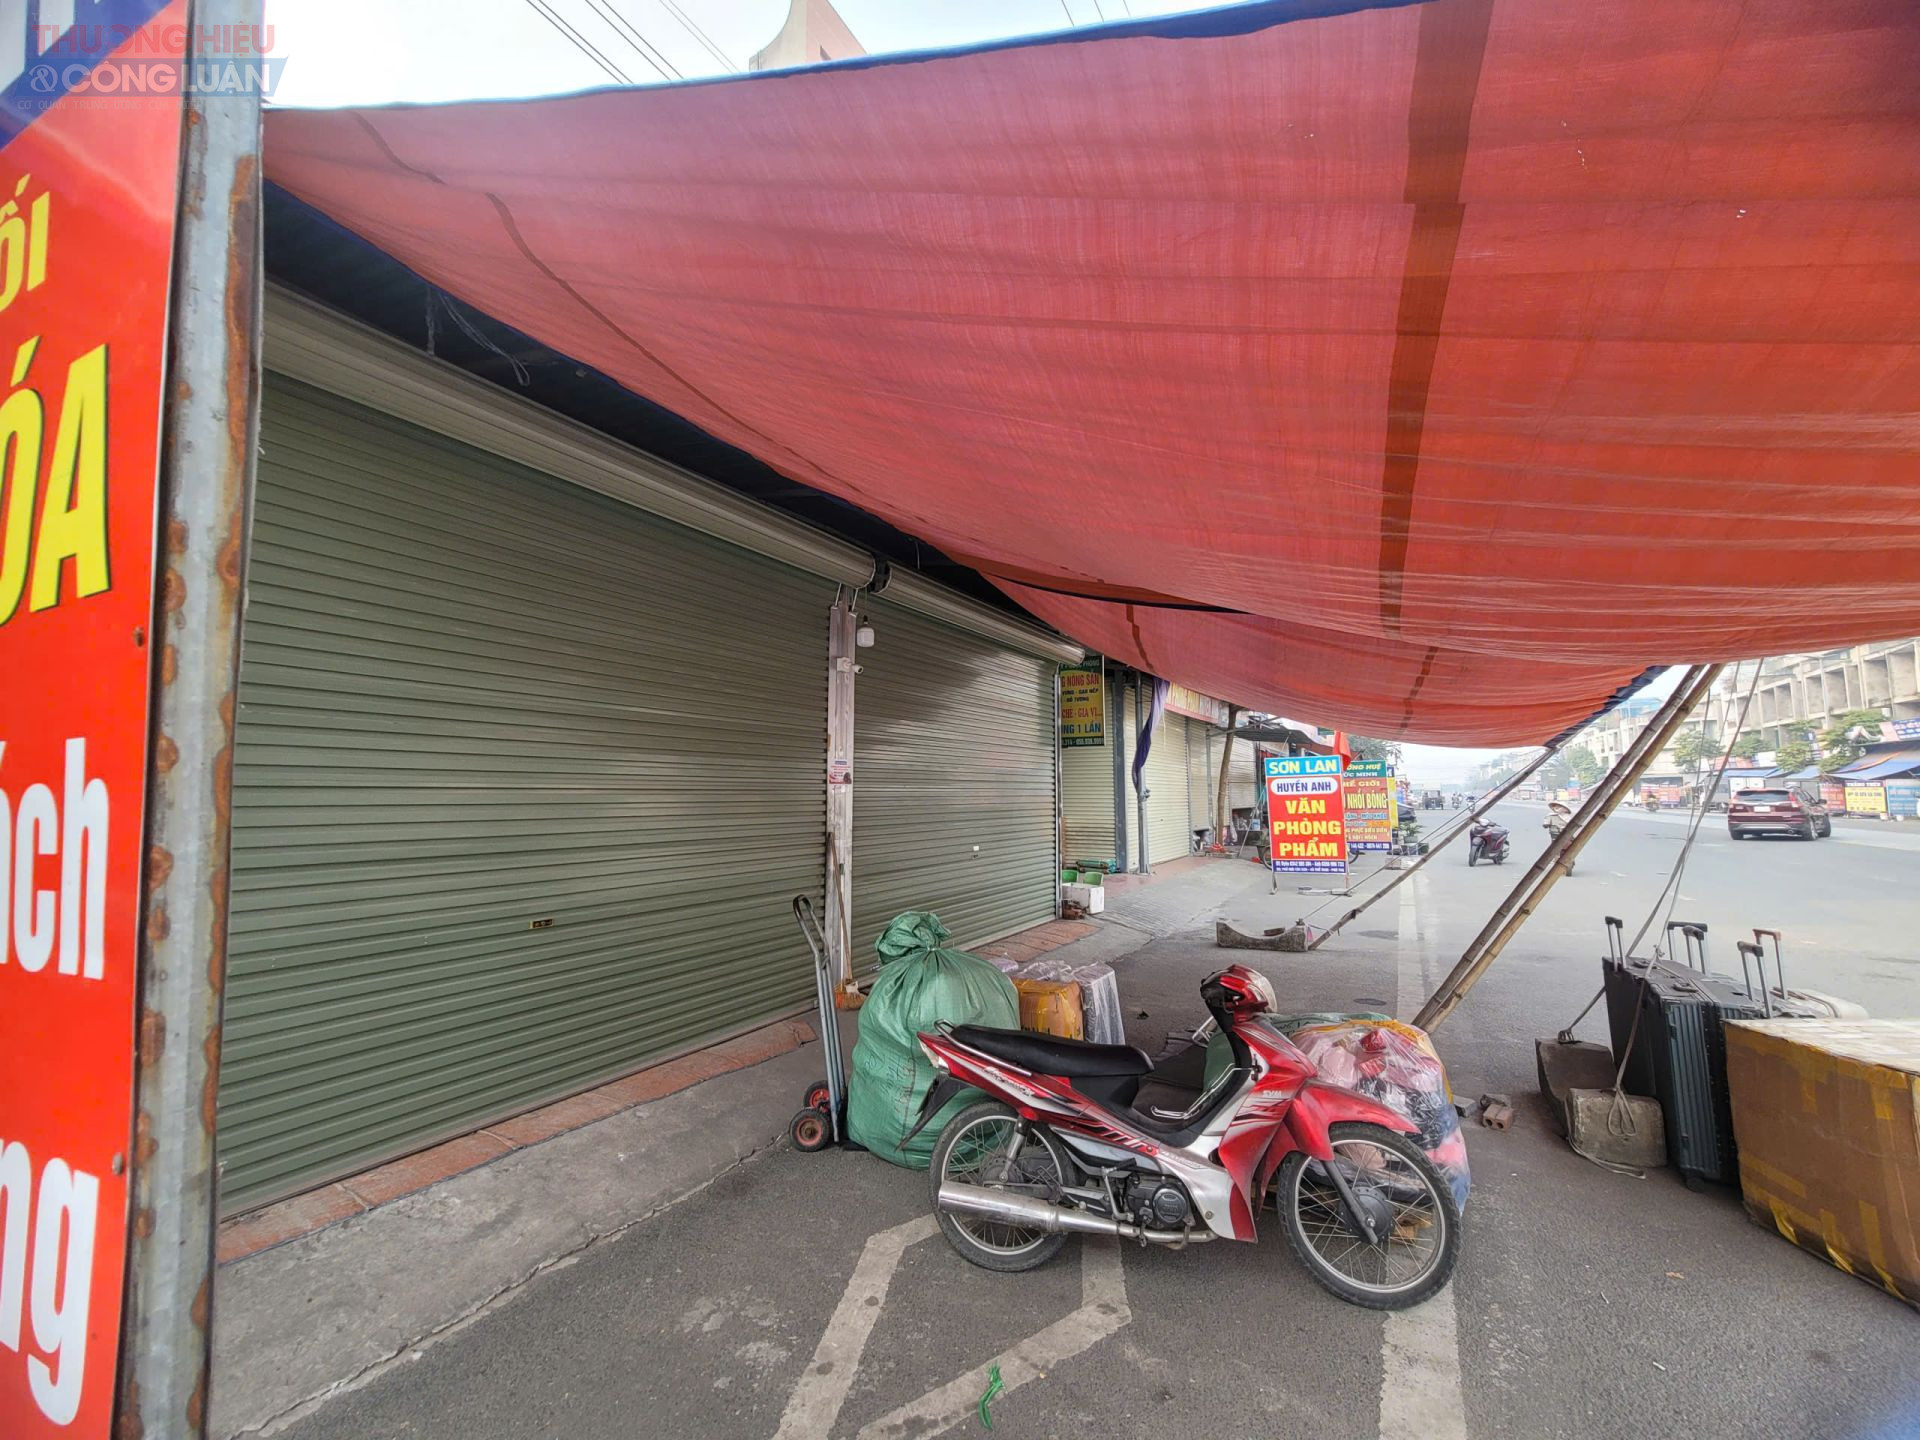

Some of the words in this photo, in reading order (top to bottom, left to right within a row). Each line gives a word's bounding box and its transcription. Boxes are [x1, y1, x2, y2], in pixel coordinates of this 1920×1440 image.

[1269, 760, 1300, 775] SƠN
[1305, 759, 1337, 773] LAN
[1311, 781, 1332, 792] ANH
[1285, 797, 1326, 815] VĂN
[1273, 818, 1342, 836] PHÒNG
[1279, 837, 1338, 857] PHẨM
